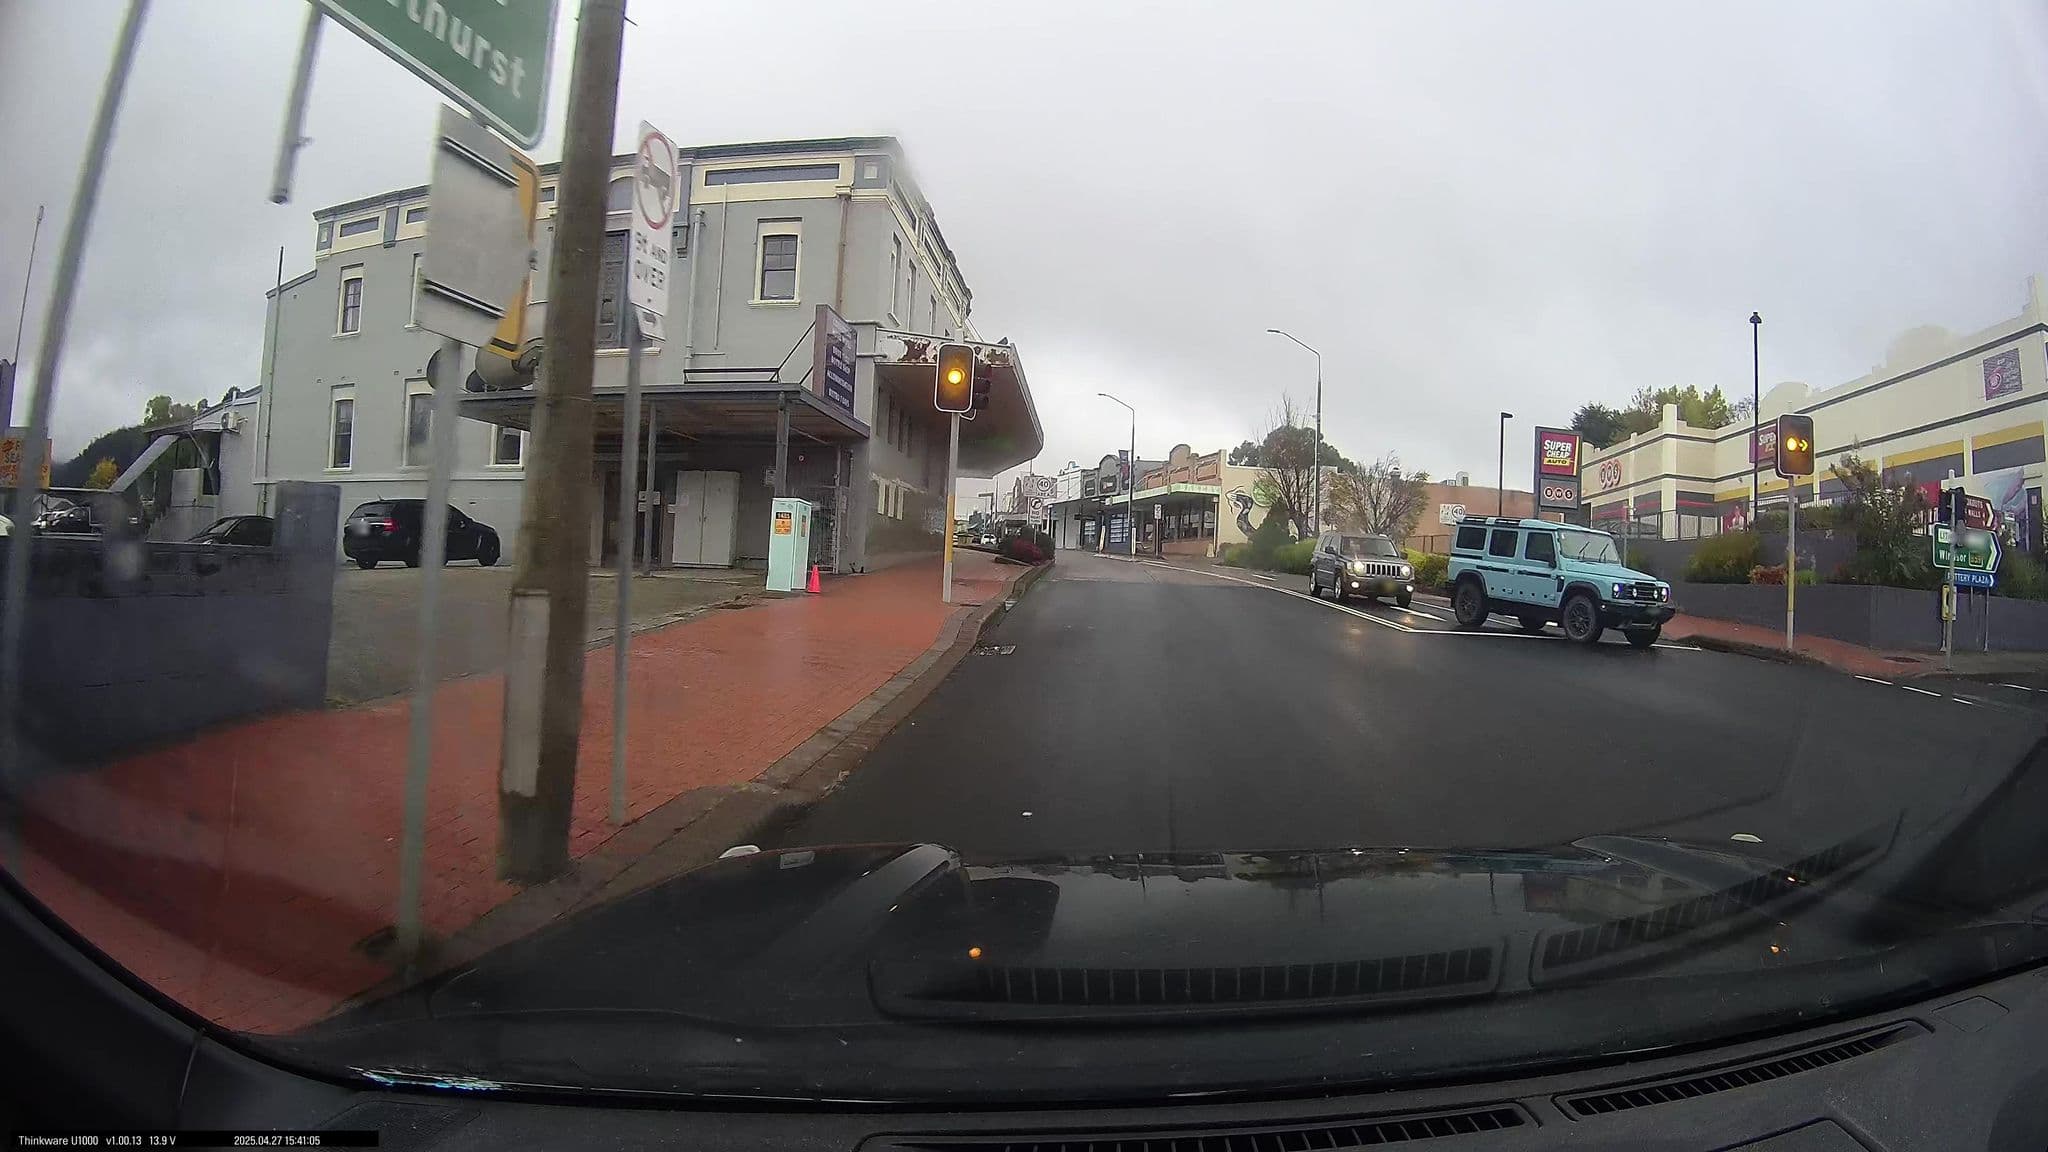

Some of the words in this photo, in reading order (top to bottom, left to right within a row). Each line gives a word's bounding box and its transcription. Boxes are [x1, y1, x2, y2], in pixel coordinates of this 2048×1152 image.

[387, 0, 525, 98] thurst
[1543, 440, 1572, 452] SUPER
[1546, 450, 1570, 458] CHEAP
[1545, 488, 1573, 500] BWS
[1939, 549, 1967, 562] Winsor
[1947, 572, 1971, 582] PTTERY
[1971, 574, 1990, 584] PLAZA
